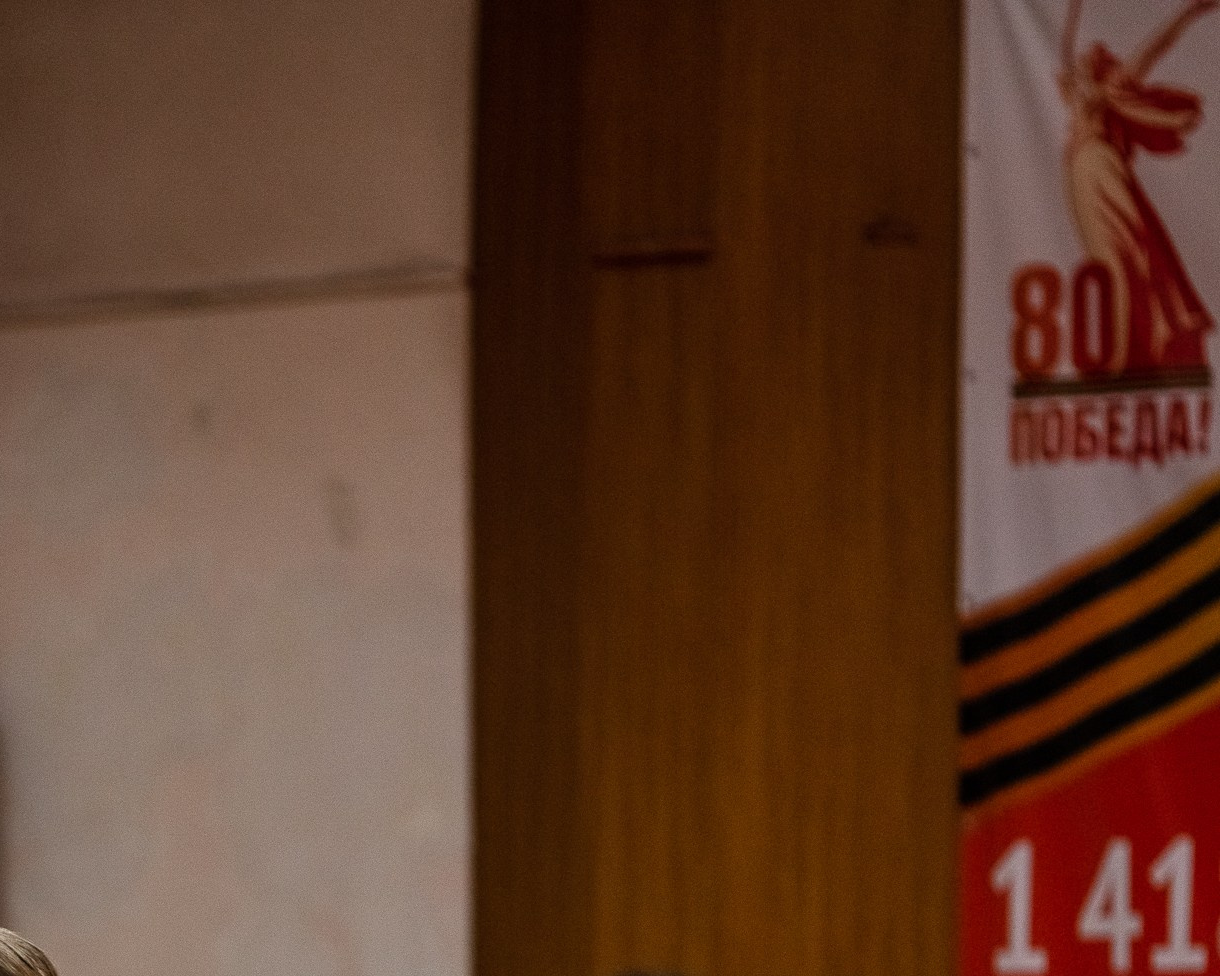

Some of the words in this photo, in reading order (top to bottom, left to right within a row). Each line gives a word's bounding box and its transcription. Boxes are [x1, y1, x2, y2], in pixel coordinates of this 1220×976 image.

[1010, 262, 1114, 376] 80
[1009, 394, 1212, 468] ПОБЕДА!
[1076, 834, 1220, 976] 41
